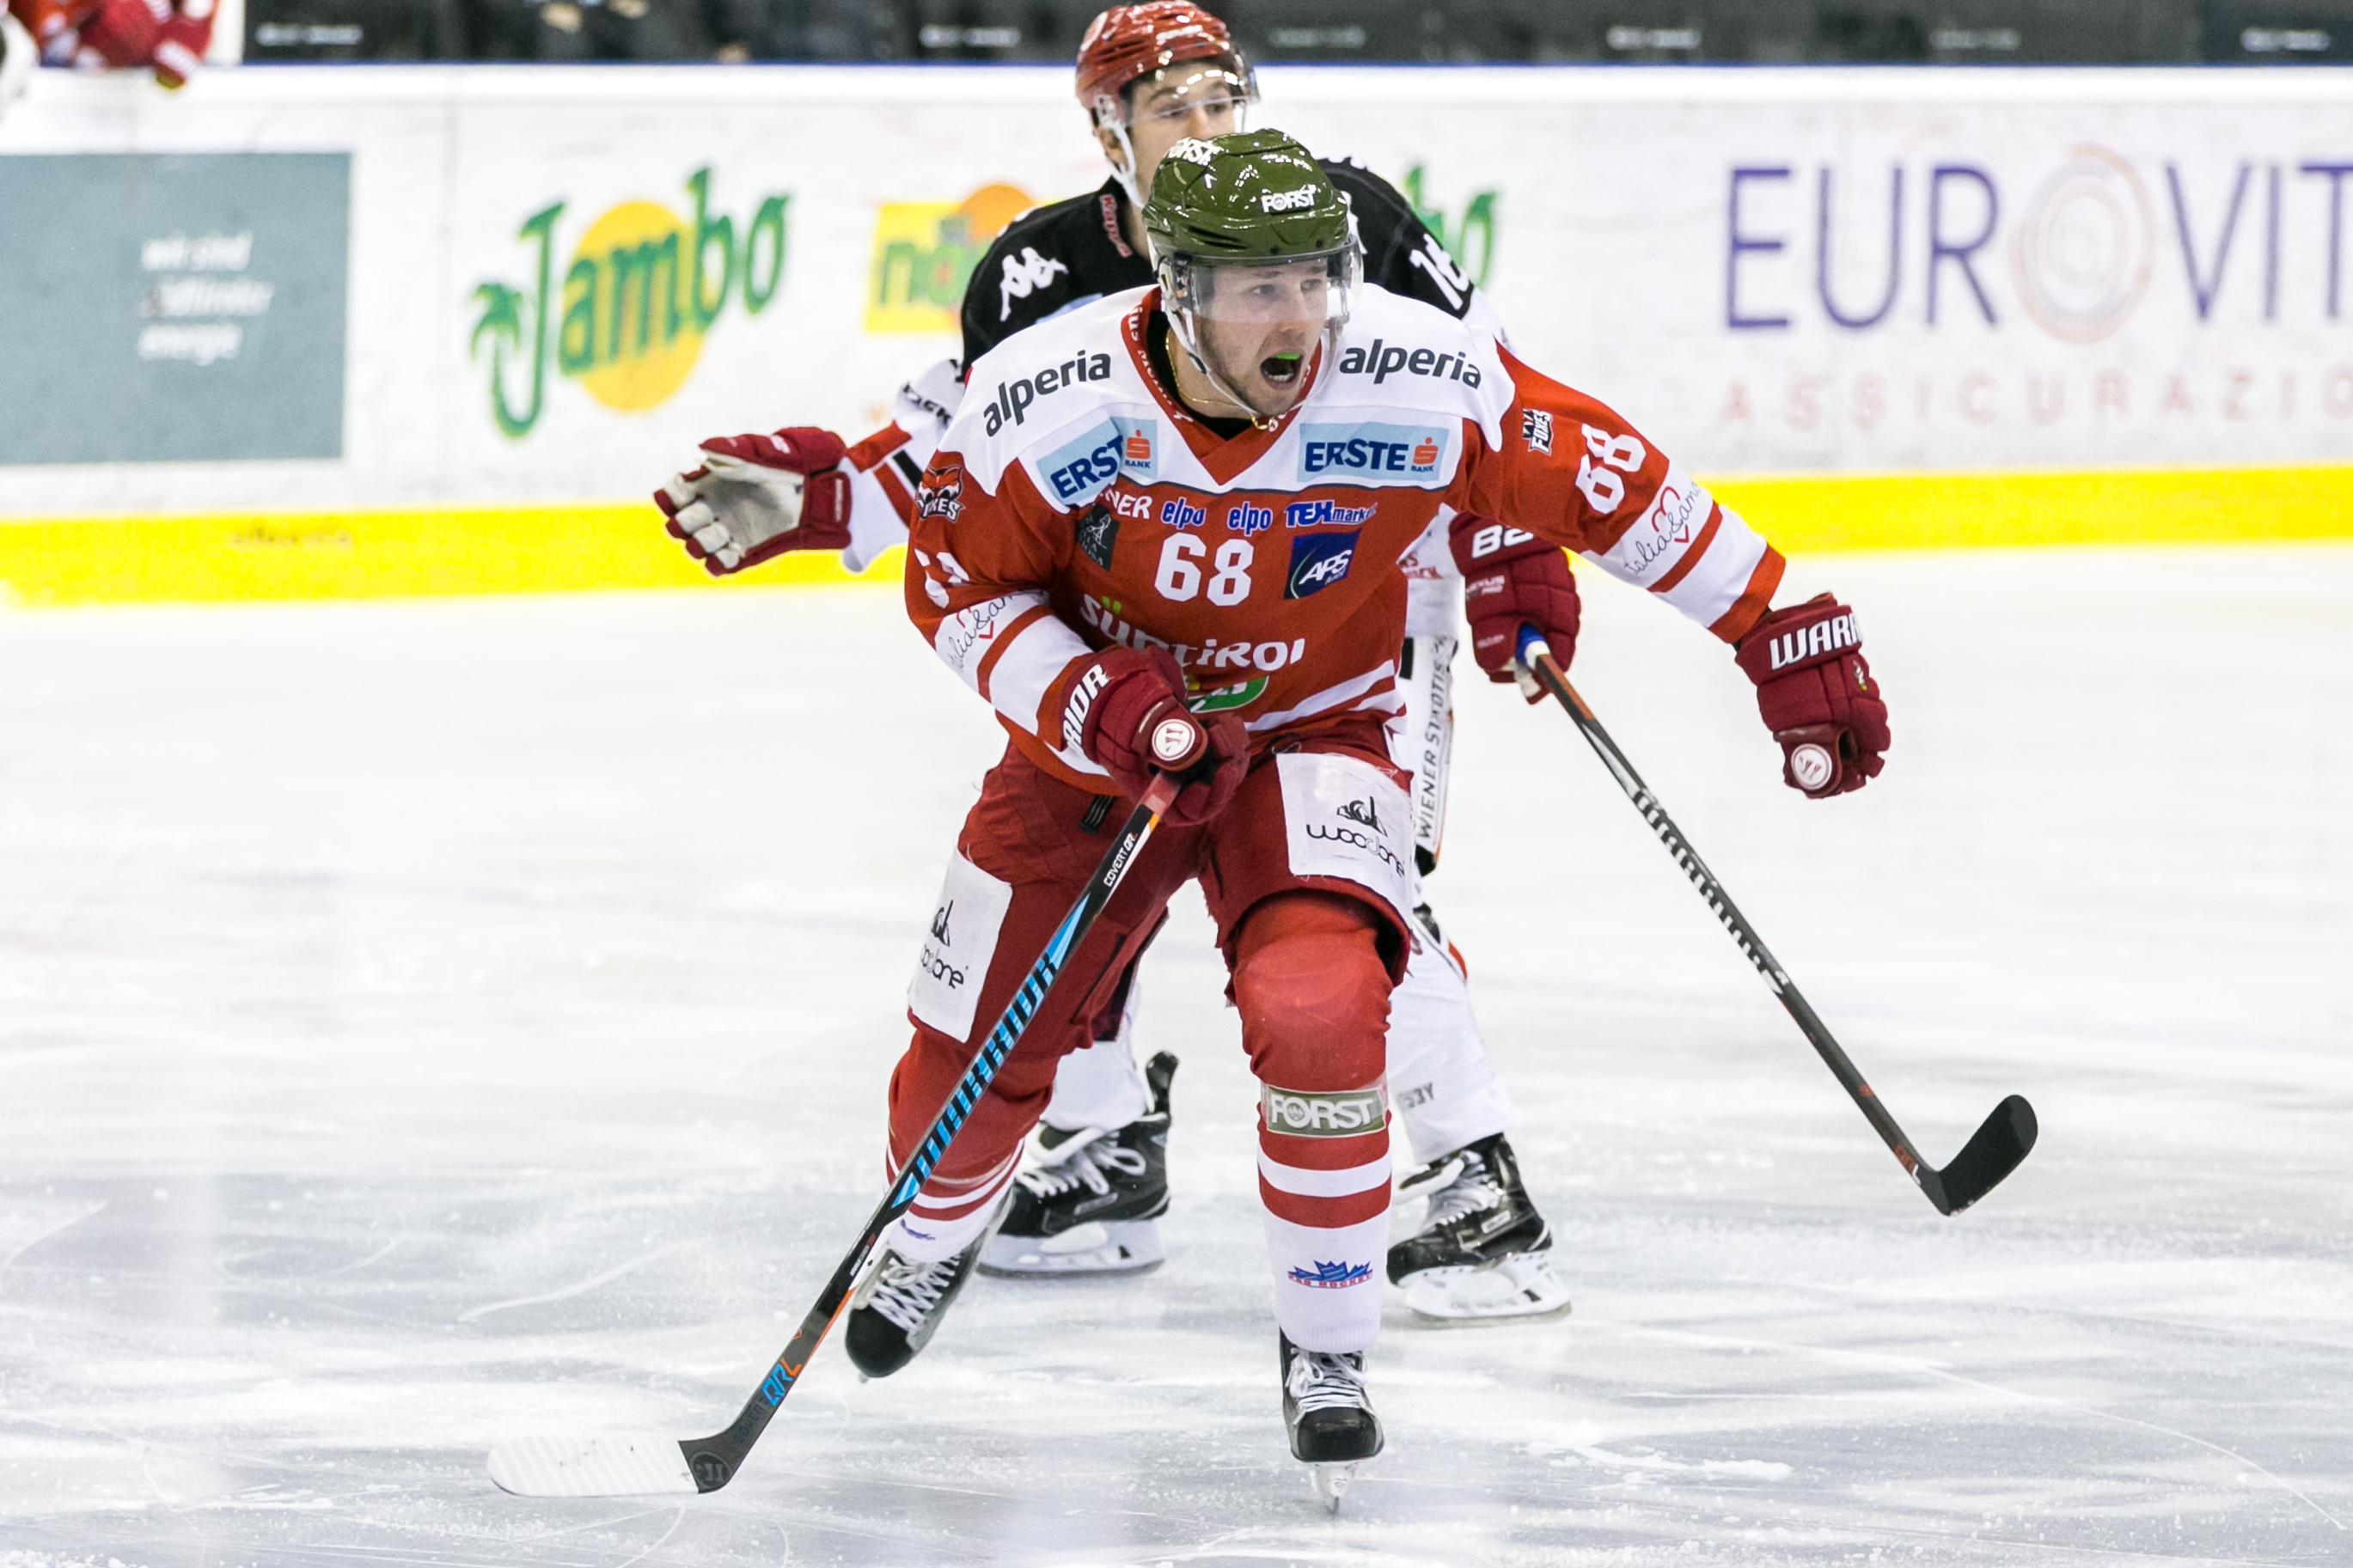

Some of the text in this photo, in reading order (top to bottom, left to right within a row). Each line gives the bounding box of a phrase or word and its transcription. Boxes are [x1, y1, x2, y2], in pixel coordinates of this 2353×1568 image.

[1261, 189, 1316, 213] FORST
[473, 167, 792, 439] Jambo
[1339, 339, 1482, 389] alperia
[983, 350, 1111, 437] alperia
[1124, 460, 1151, 469] BANK
[1305, 438, 1409, 472] ERSTE
[1575, 423, 1647, 515] 68
[1161, 497, 1206, 529] elpo
[1227, 501, 1273, 536] elpo
[1154, 532, 1255, 607] 68
[1299, 549, 1352, 584] APS
[1103, 846, 1128, 888] COVERT
[1306, 824, 1405, 878] woodone
[1270, 1093, 1374, 1130] FORST
[1318, 1273, 1372, 1288] HOCKEY
